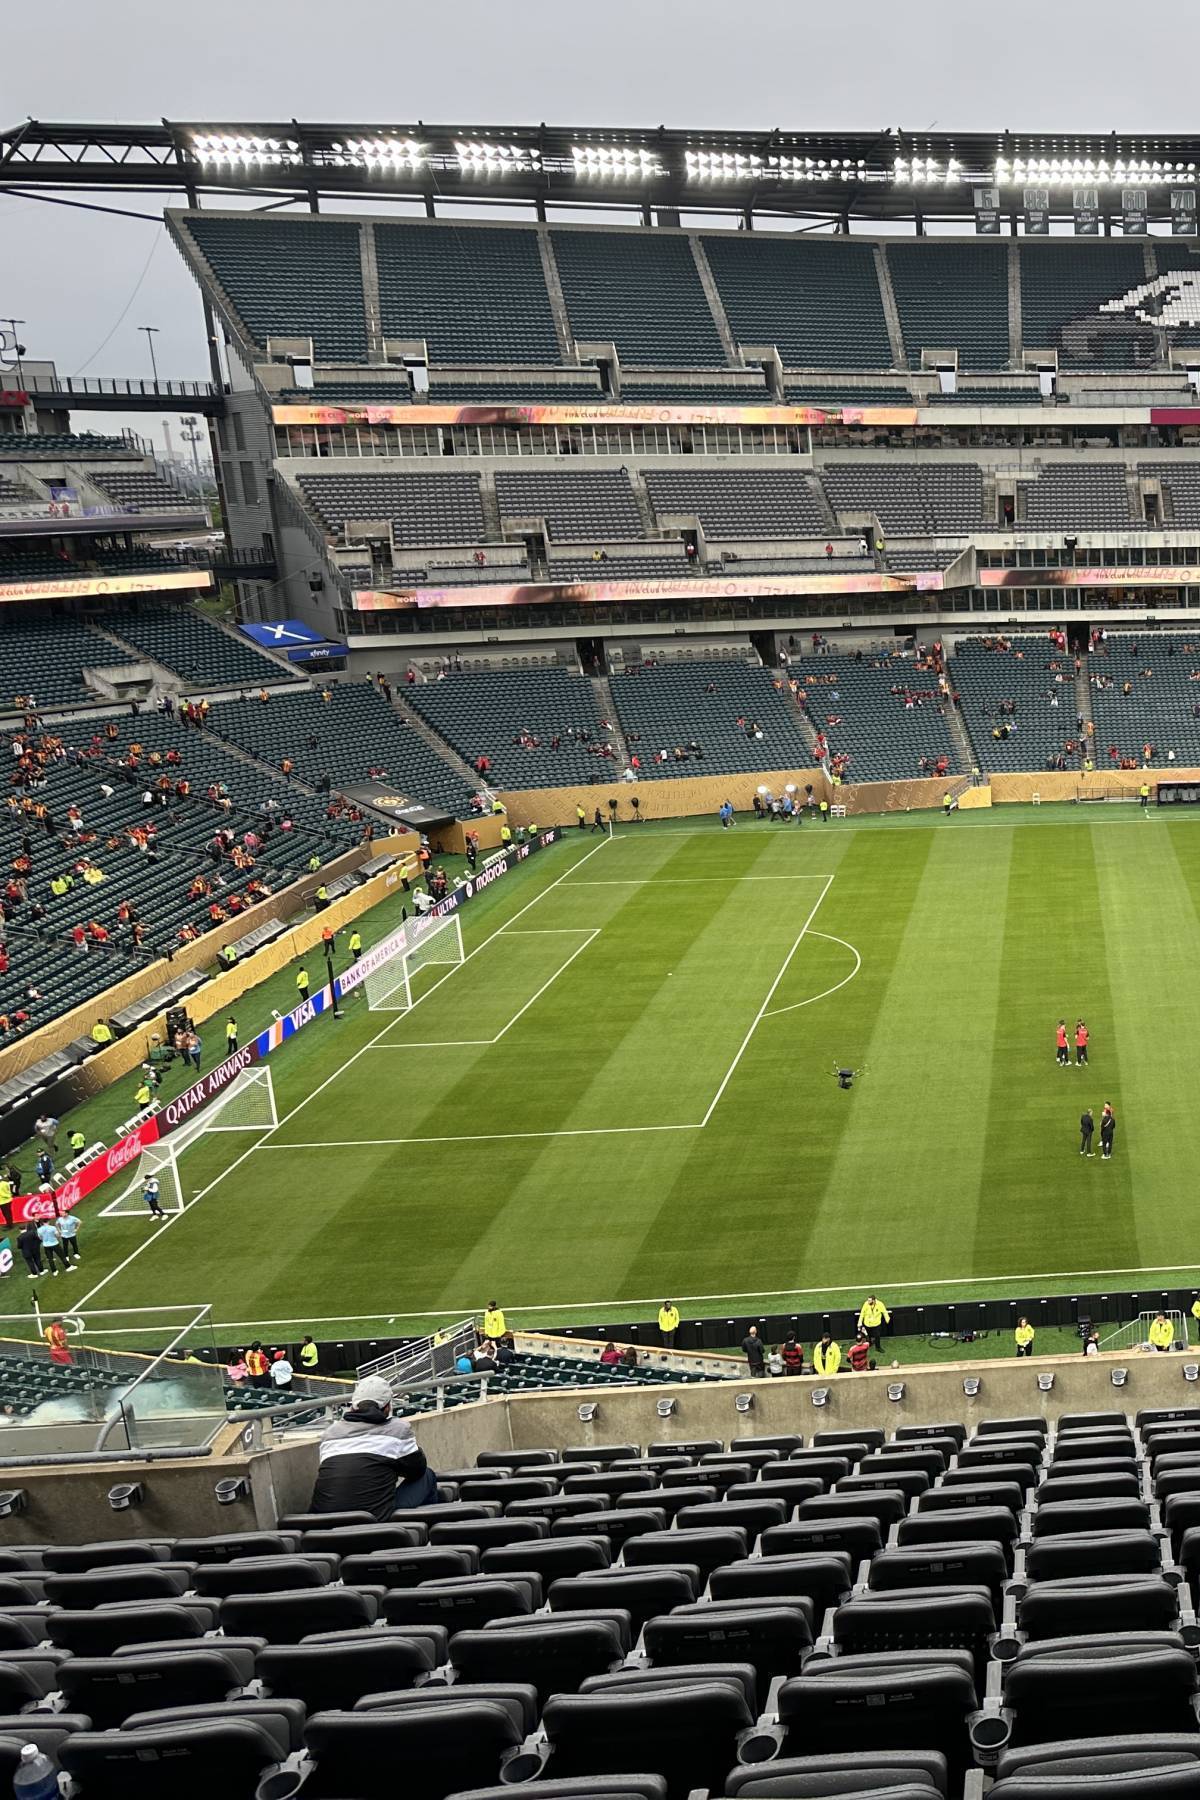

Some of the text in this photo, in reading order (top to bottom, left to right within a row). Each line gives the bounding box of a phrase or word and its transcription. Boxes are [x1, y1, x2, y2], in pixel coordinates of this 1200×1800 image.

[1171, 190, 1194, 210] 70
[309, 648, 330, 658] xfinity
[545, 832, 555, 845] PIF
[521, 849, 531, 862] PIF
[475, 860, 508, 892] motorola
[437, 895, 458, 917] ULTRA
[341, 941, 400, 990] BANK OF AMERICA
[289, 999, 317, 1031] VISA
[165, 1046, 252, 1125] QATAR AIRWAYS
[106, 1131, 142, 1174] Coca-Cola
